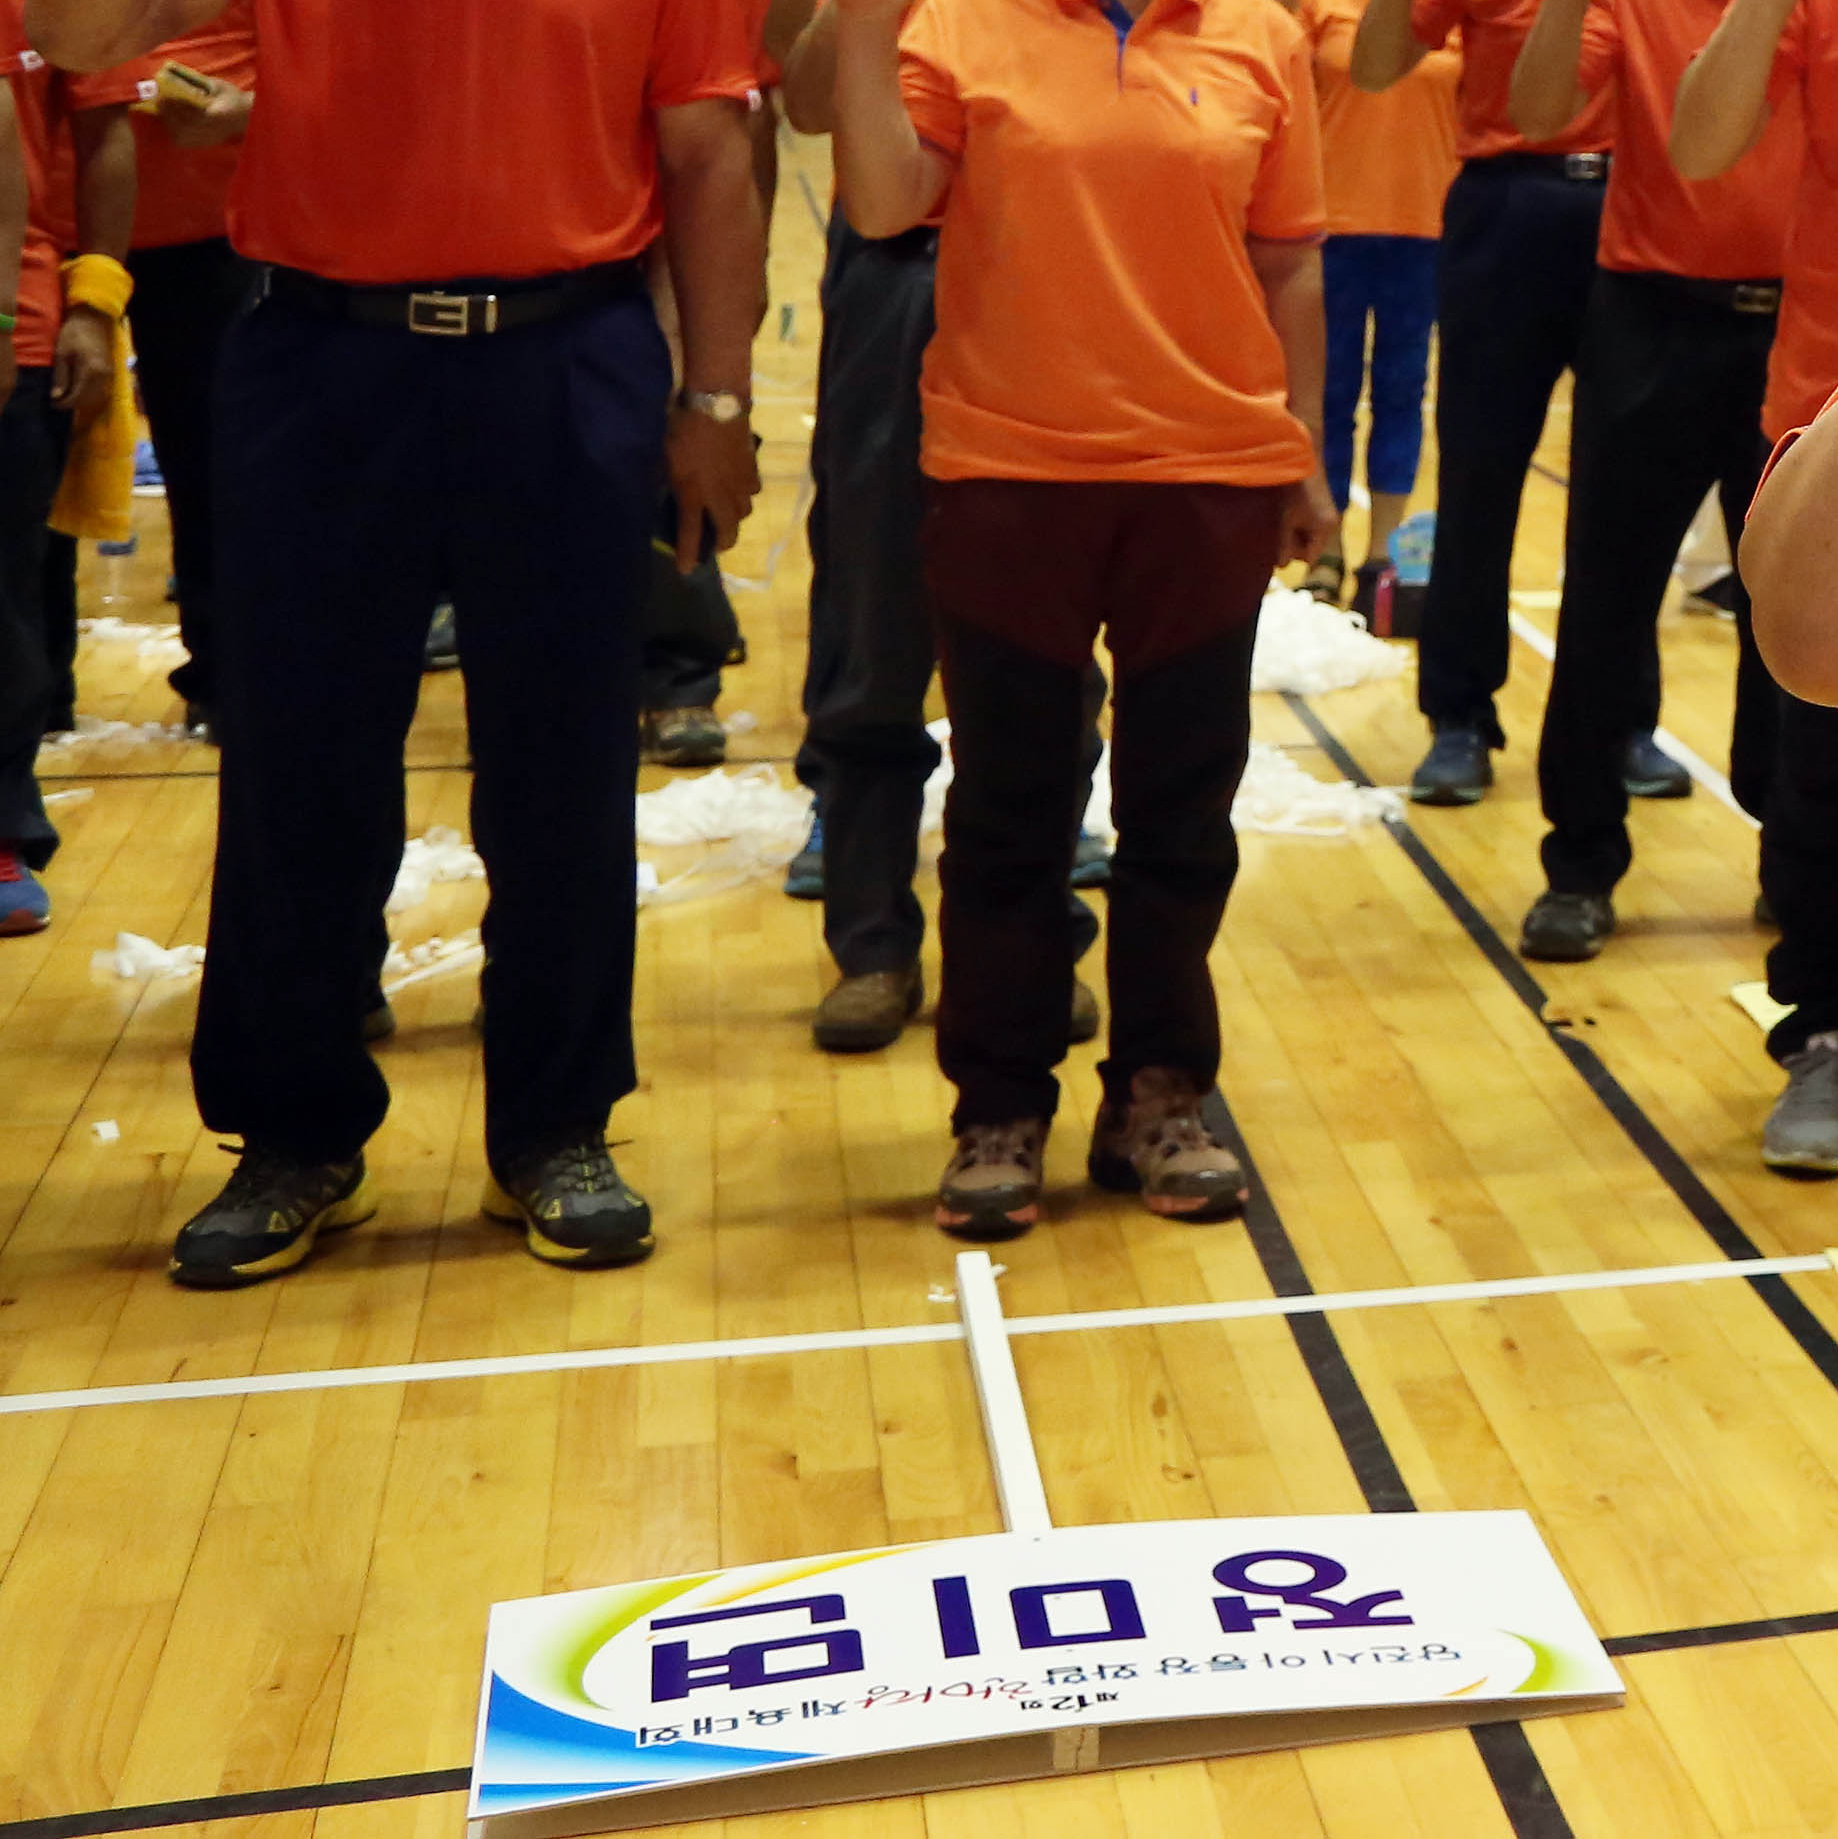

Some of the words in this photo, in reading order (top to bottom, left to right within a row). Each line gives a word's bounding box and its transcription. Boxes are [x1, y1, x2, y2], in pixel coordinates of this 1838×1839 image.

[650, 1549, 1415, 1703] 정미면
[1322, 1643, 1461, 1666] 당진시
[1042, 1663, 1139, 1686] 화합
[855, 1677, 1033, 1709] 한마당
[1019, 1690, 1119, 1713] 제12회
[640, 1699, 847, 1745] 체육대회
